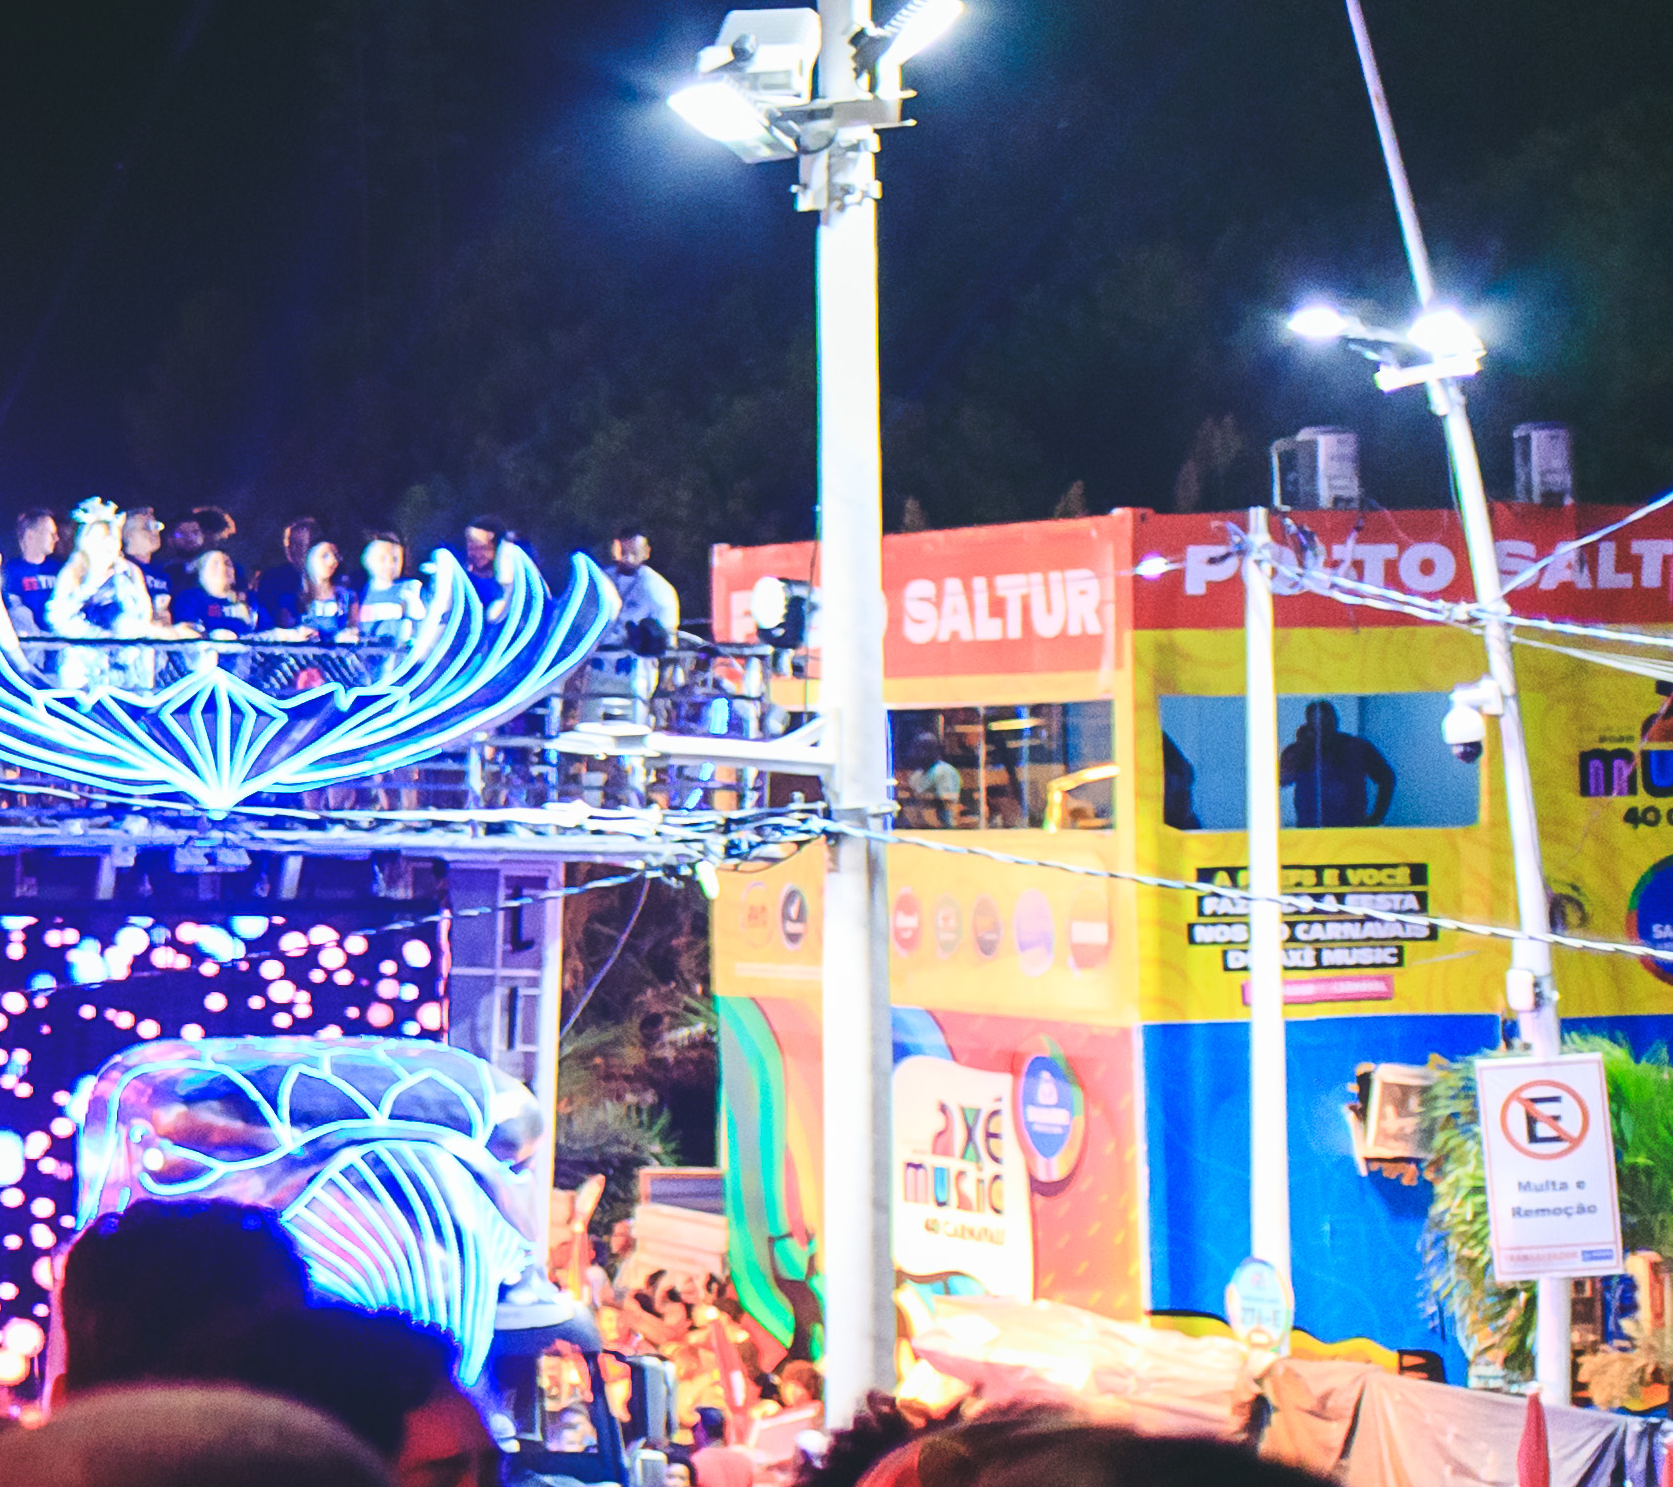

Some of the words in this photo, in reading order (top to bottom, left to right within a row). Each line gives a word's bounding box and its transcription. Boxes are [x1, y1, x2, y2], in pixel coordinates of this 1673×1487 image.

[903, 568, 1102, 645] SALTUR
[1623, 806, 1662, 829] 40
[1192, 922, 1248, 943] NOS
[1320, 946, 1399, 967] MUSIC
[1517, 1179, 1569, 1193] Multa
[1575, 1179, 1587, 1190] e
[1511, 1202, 1598, 1219] Remoção
